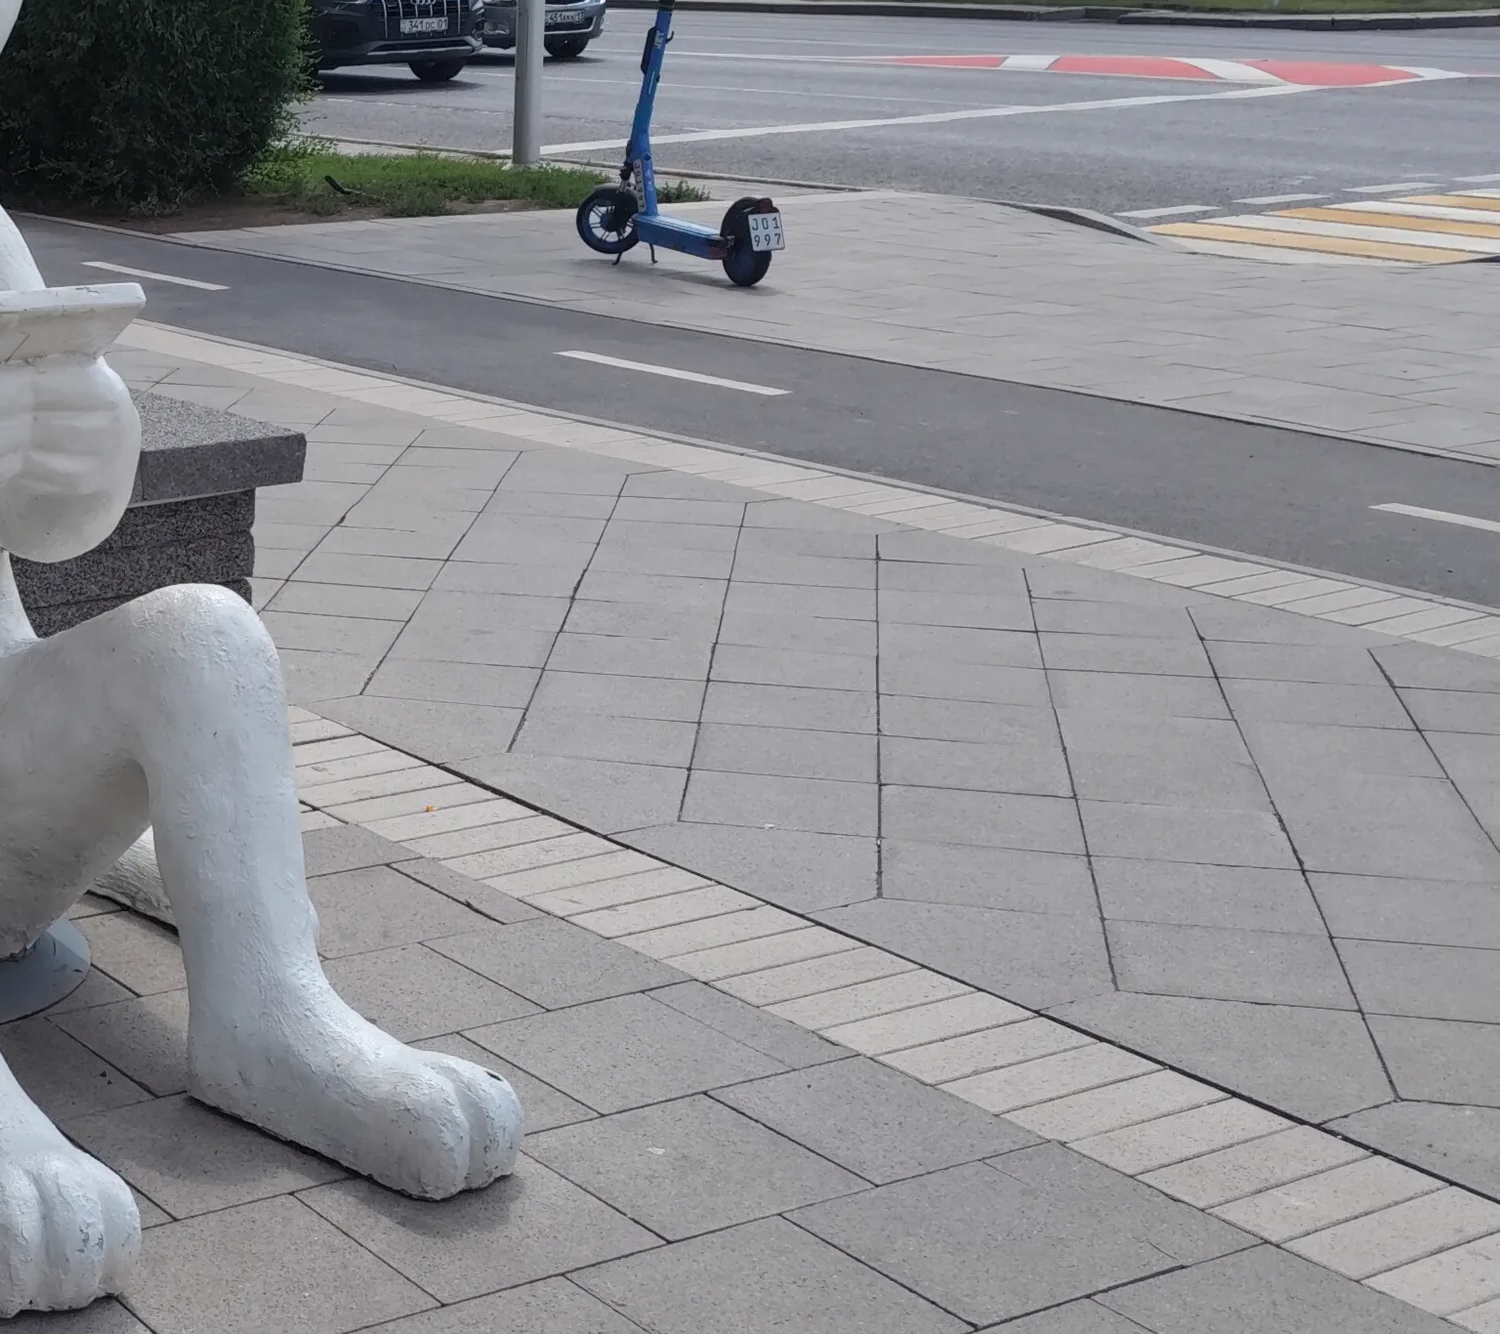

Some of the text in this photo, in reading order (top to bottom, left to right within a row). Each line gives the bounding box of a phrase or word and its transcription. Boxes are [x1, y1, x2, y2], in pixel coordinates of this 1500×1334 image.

[409, 20, 423, 31] 341
[438, 19, 447, 28] 01
[752, 217, 780, 230] J01
[754, 233, 781, 247] 997
